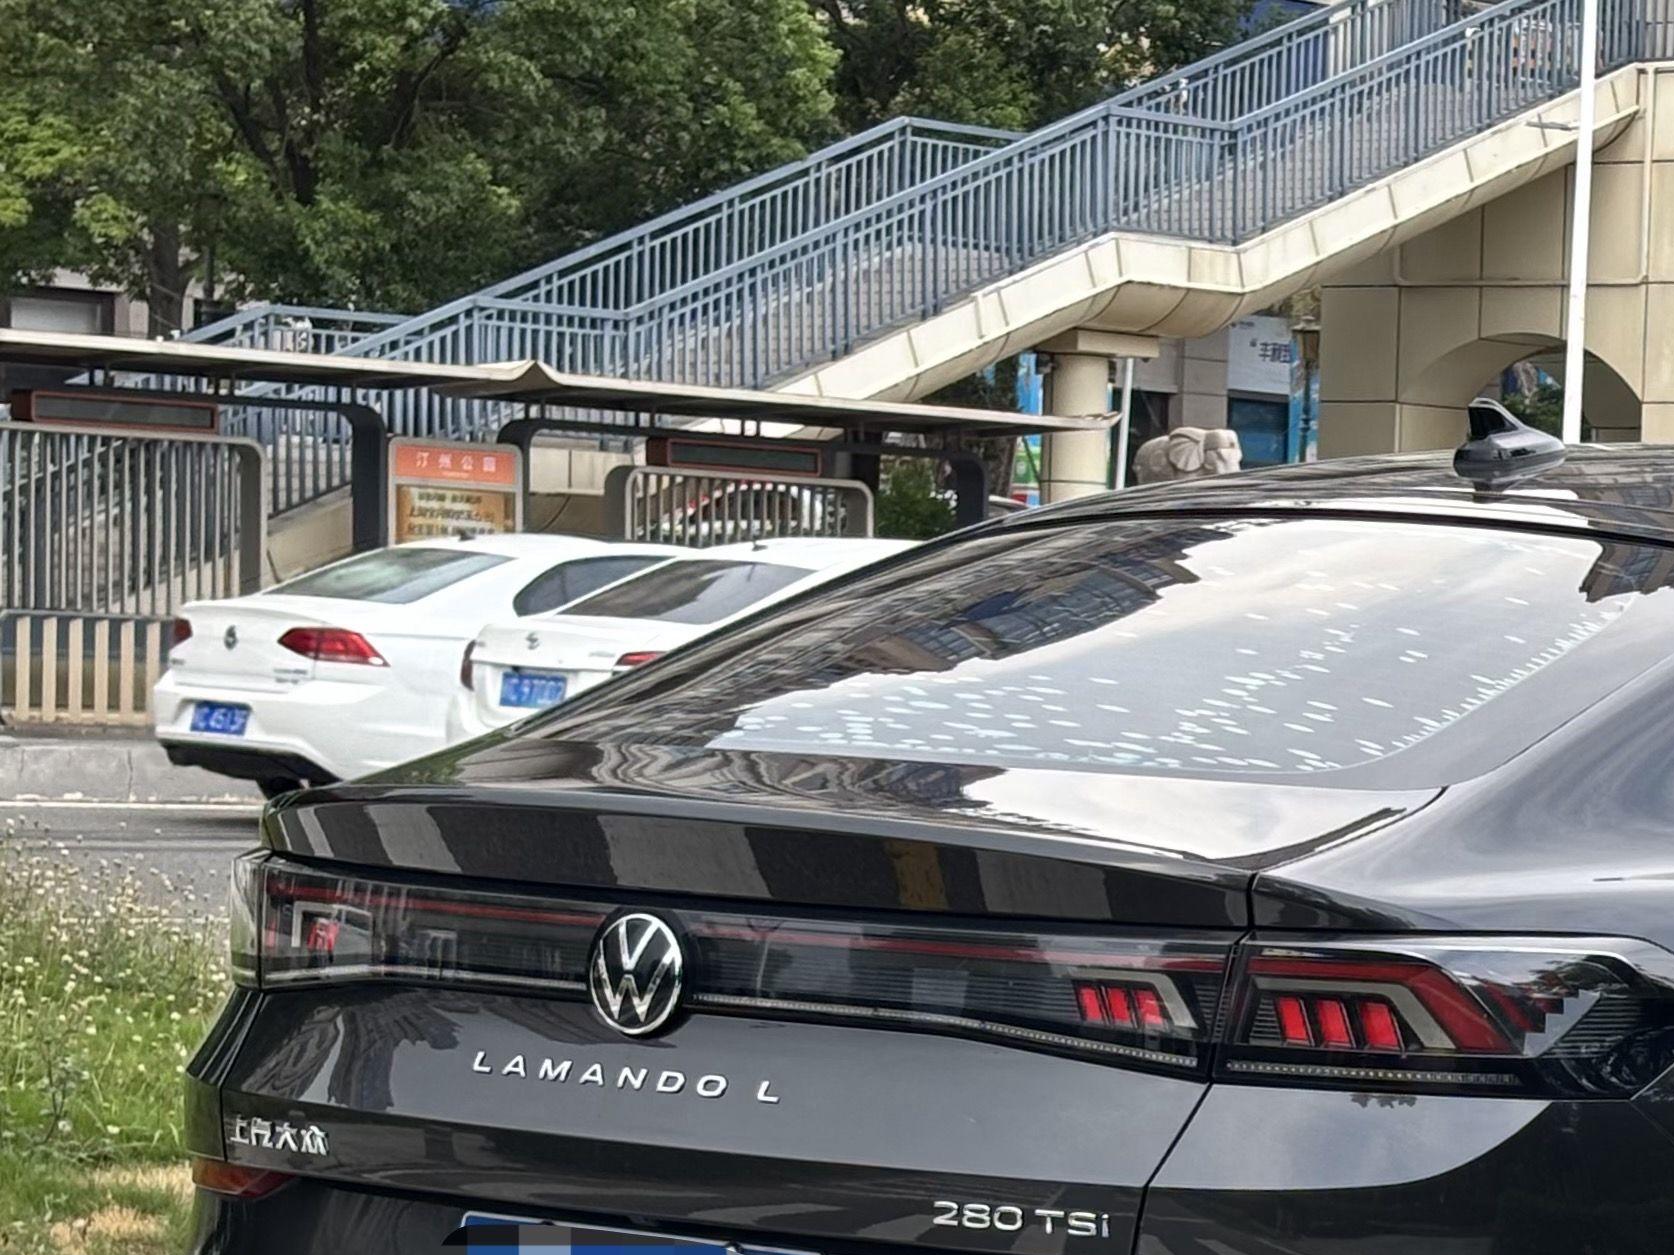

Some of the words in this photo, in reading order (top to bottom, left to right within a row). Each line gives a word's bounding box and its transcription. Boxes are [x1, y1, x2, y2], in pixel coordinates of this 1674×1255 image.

[472, 1050, 729, 1099] LAMANDO
[756, 1079, 781, 1103] L
[230, 1113, 329, 1156] 上汽大众
[932, 1200, 1024, 1231] 280
